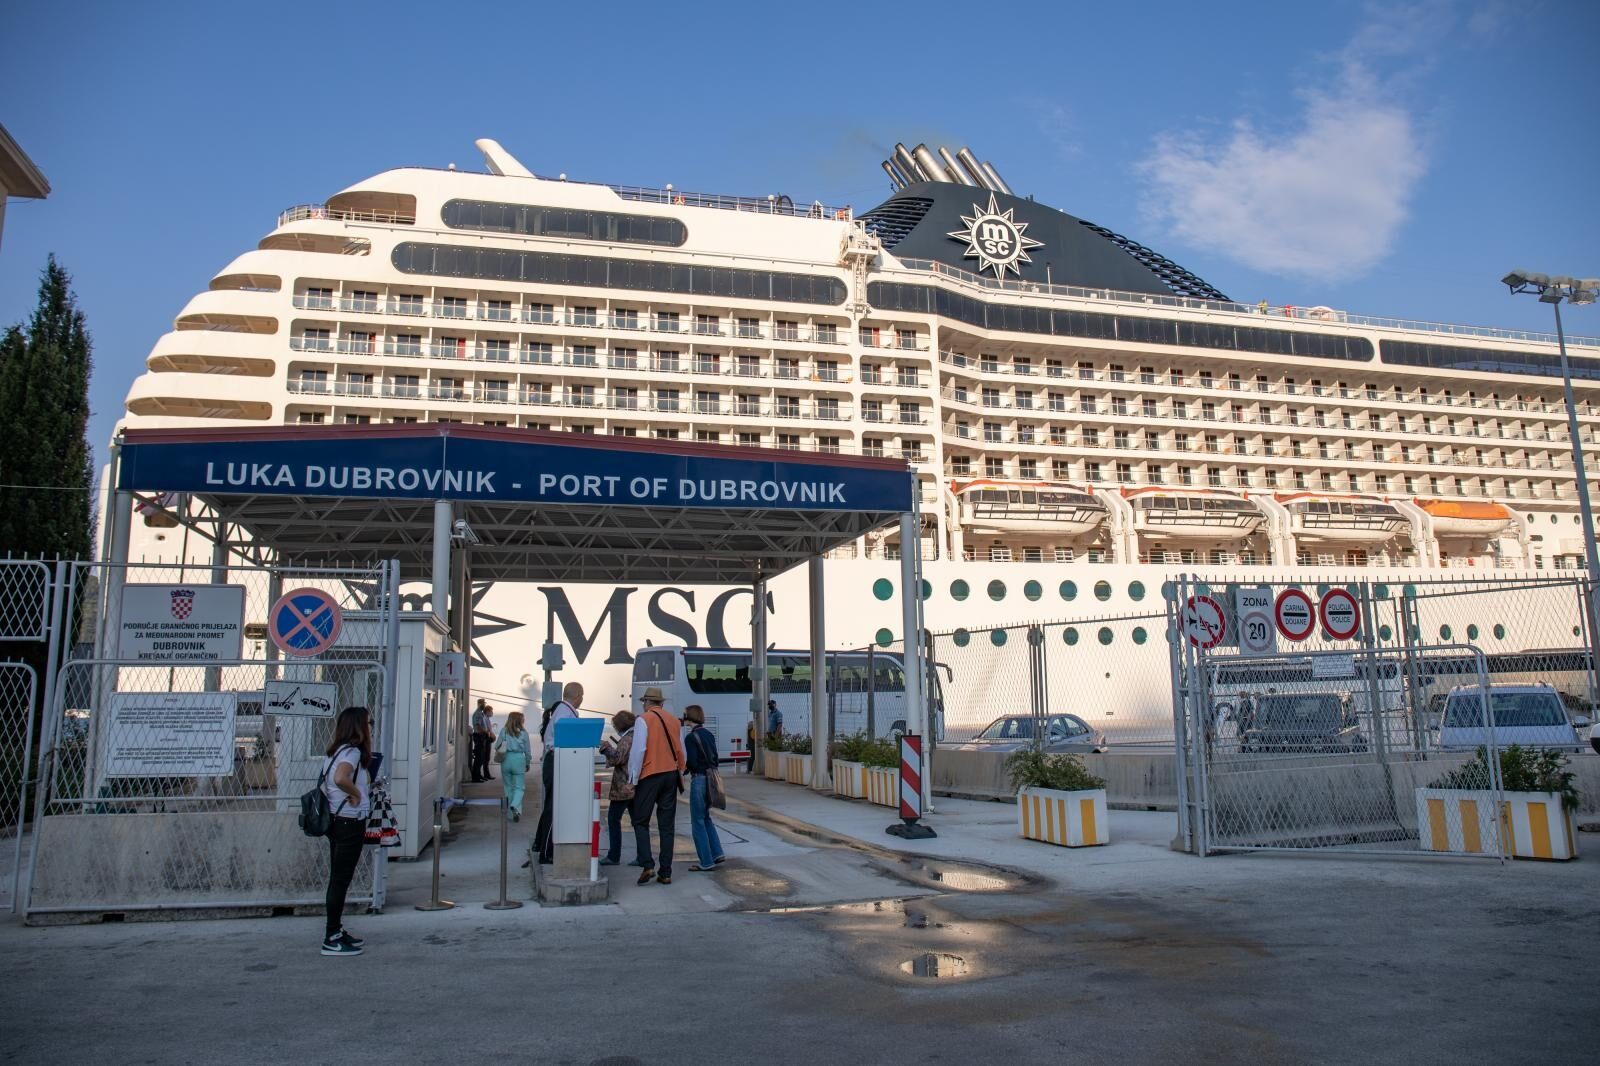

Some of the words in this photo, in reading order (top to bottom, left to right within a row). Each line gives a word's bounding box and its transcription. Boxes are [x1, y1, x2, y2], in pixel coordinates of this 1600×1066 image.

[206, 462, 296, 487] LUKA
[305, 465, 497, 493] DUBROVNIK
[539, 473, 621, 497] PORT
[629, 477, 669, 498] OF
[679, 479, 846, 503] DUBROVNIK
[1243, 598, 1269, 606] ZONA
[537, 586, 776, 665] MSC
[1249, 622, 1266, 640] 20
[152, 641, 206, 650] DUBROVNIK
